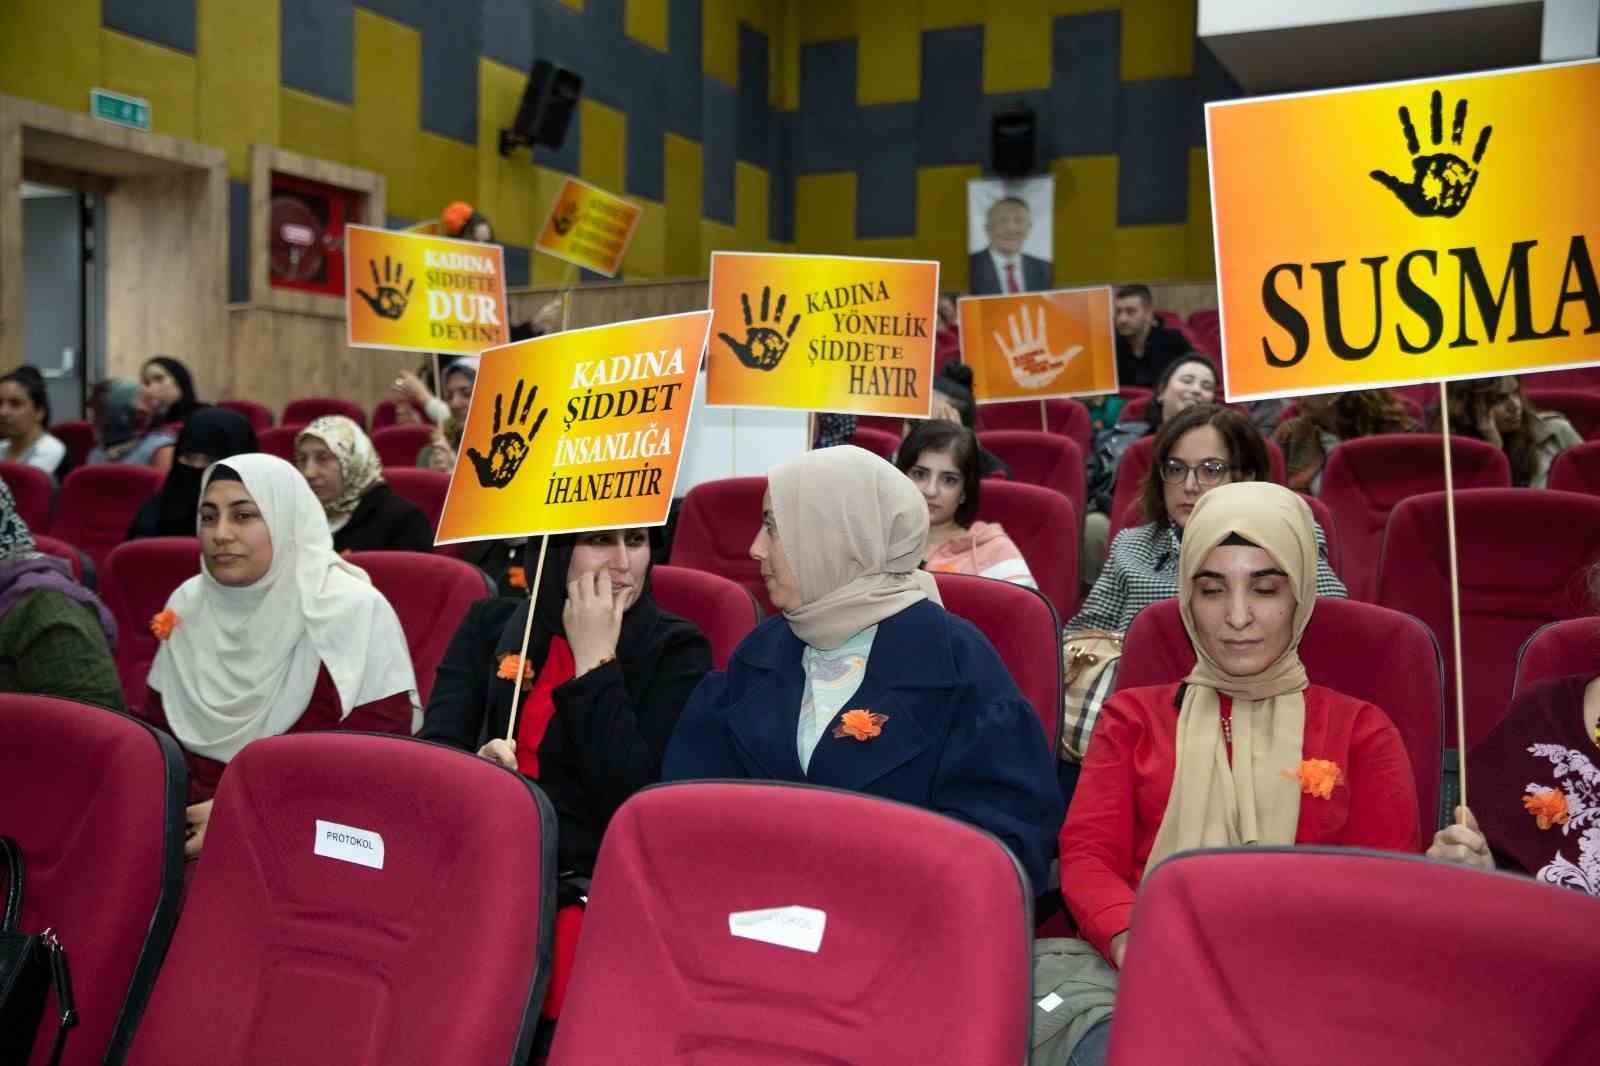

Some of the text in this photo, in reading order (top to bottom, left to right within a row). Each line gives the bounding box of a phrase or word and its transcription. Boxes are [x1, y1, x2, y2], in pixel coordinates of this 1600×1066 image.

[428, 290, 501, 326] DUR
[805, 280, 891, 314] KADINA
[1261, 235, 1600, 368] SUSMA
[832, 309, 928, 338] YÖNELİK
[570, 346, 685, 389] KADINA
[807, 335, 904, 368] ŞİDDETE
[848, 365, 919, 398] HAYIR
[563, 383, 682, 431] ŞİDDET
[553, 422, 672, 467] İNSANLIĞA
[544, 462, 663, 505] İHANETTİR
[326, 831, 374, 850] PROTOKOL
